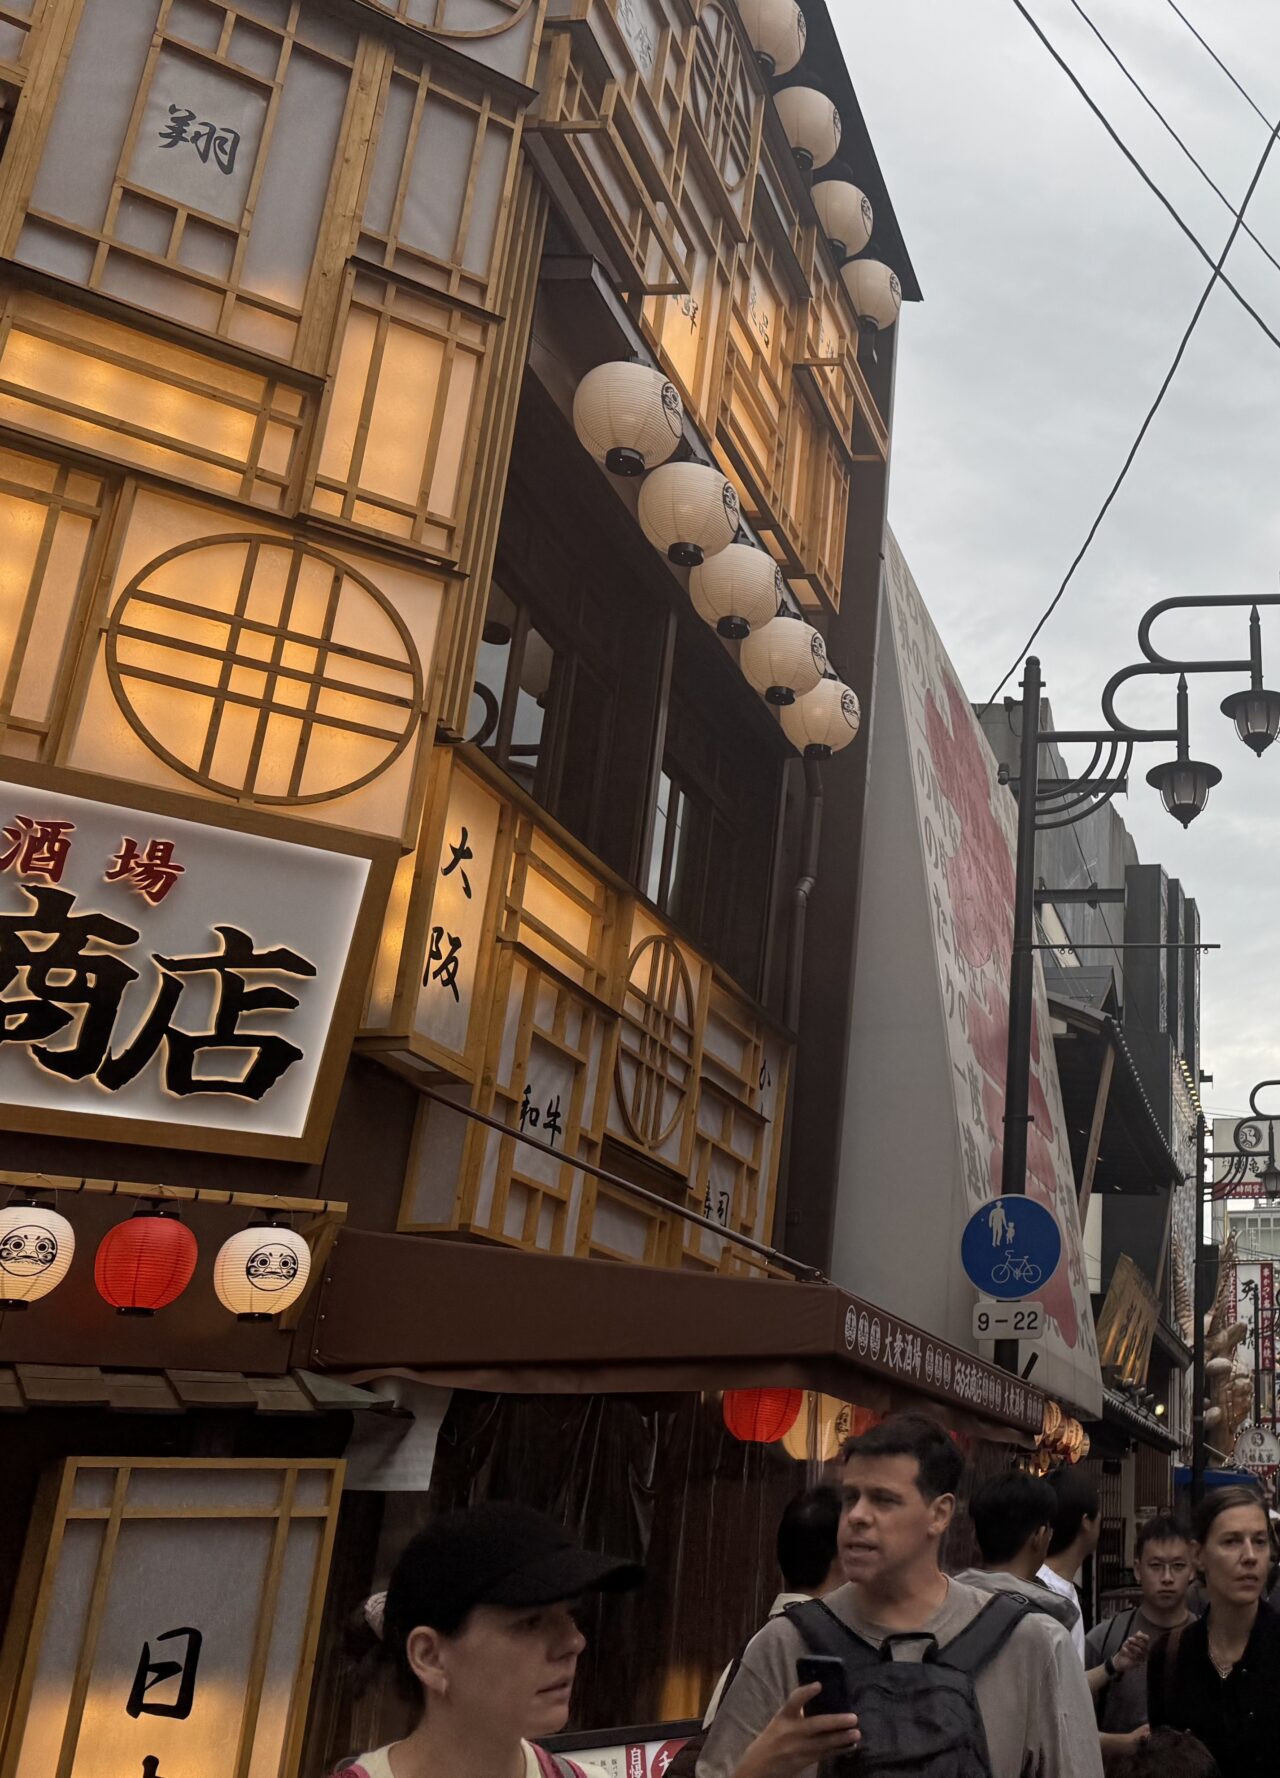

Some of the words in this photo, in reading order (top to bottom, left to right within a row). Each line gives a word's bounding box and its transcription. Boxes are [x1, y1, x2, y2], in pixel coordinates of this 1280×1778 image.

[158, 104, 240, 175] 翔
[1, 815, 187, 906] 酒場
[421, 826, 478, 1005] 大阪
[0, 884, 318, 1102] 商店
[519, 1084, 562, 1147] 和牛
[882, 1321, 922, 1380] 大衆酒場
[126, 1626, 204, 1778] 日
